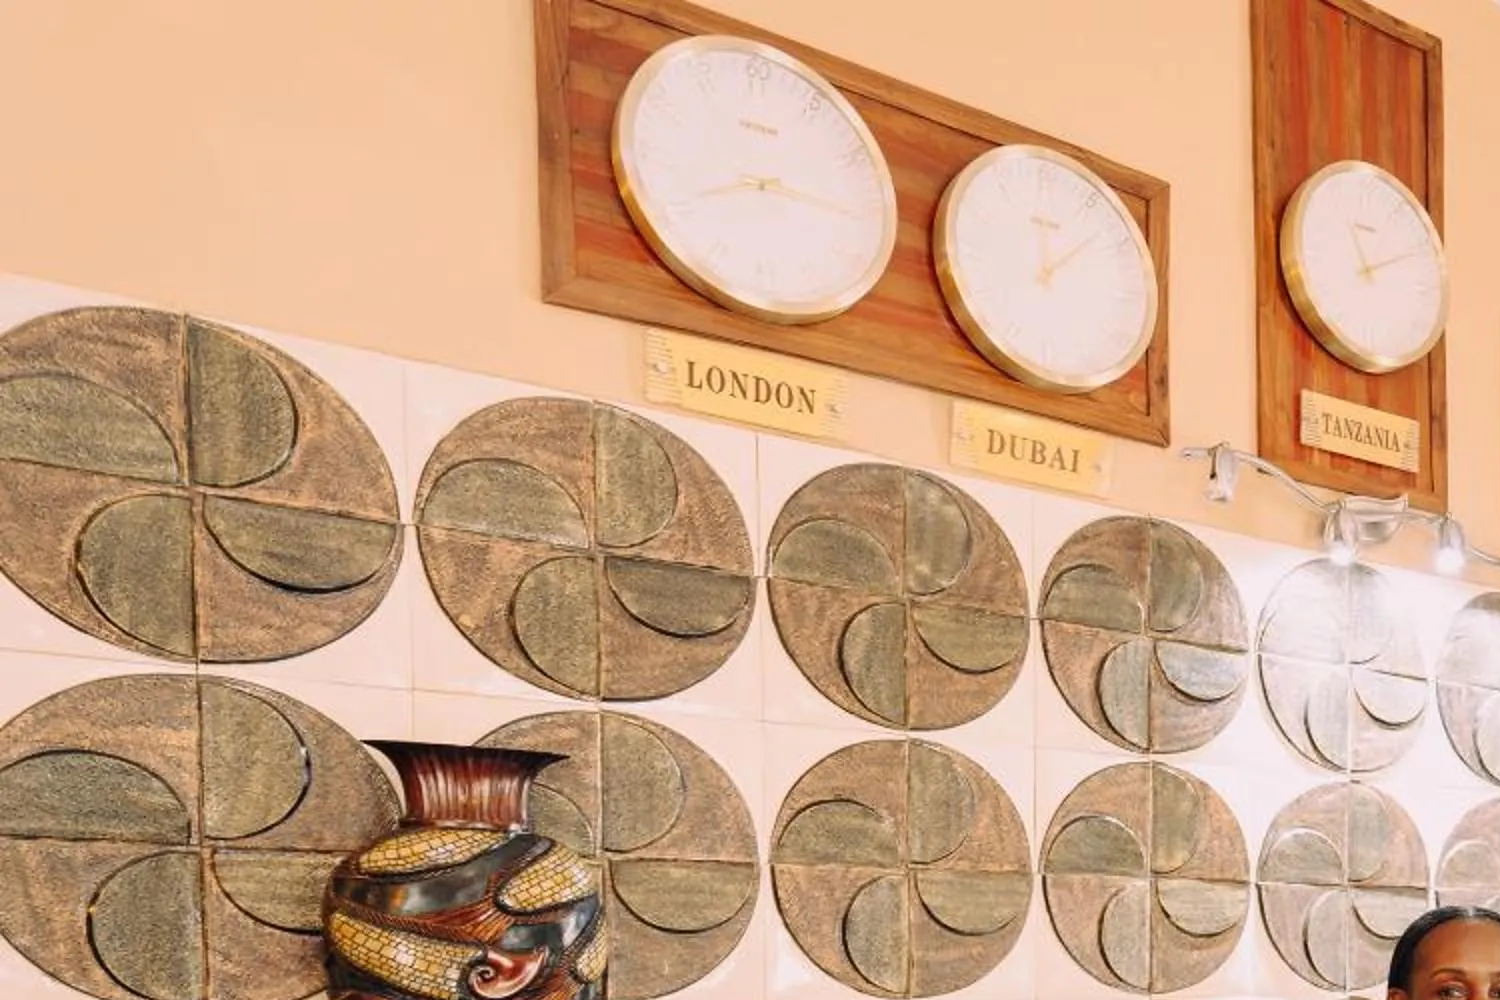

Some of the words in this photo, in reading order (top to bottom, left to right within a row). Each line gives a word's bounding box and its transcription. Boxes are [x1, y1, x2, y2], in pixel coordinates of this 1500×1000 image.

[687, 361, 817, 415] LONDON
[987, 429, 1081, 473] DUBAI
[1322, 411, 1401, 453] TANZANIA
